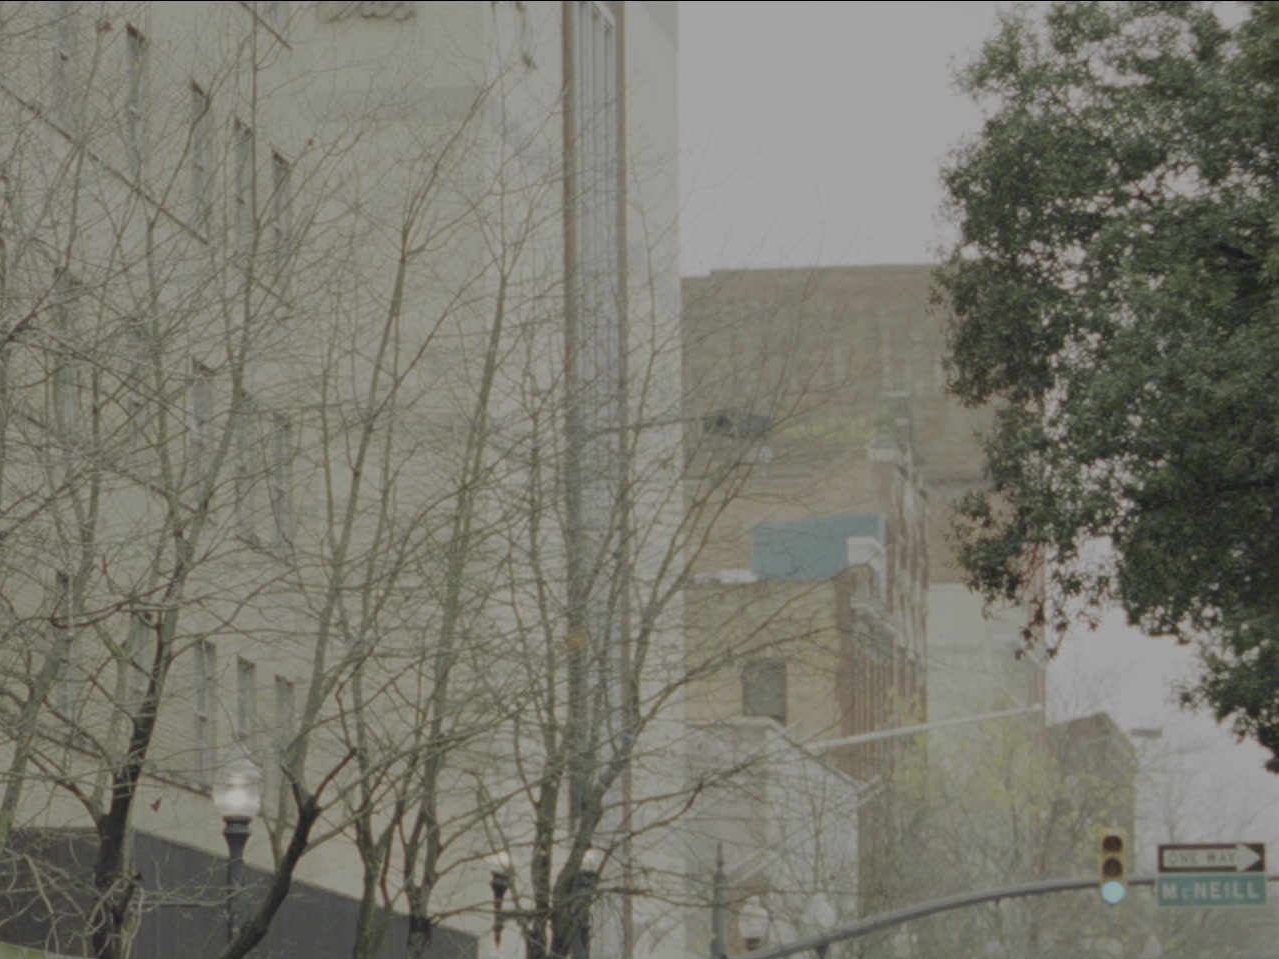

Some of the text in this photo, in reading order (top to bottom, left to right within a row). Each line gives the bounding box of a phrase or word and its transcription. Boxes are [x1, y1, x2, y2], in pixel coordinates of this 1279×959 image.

[1168, 851, 1235, 865] ONE WAY
[1162, 881, 1260, 900] McNEILL
